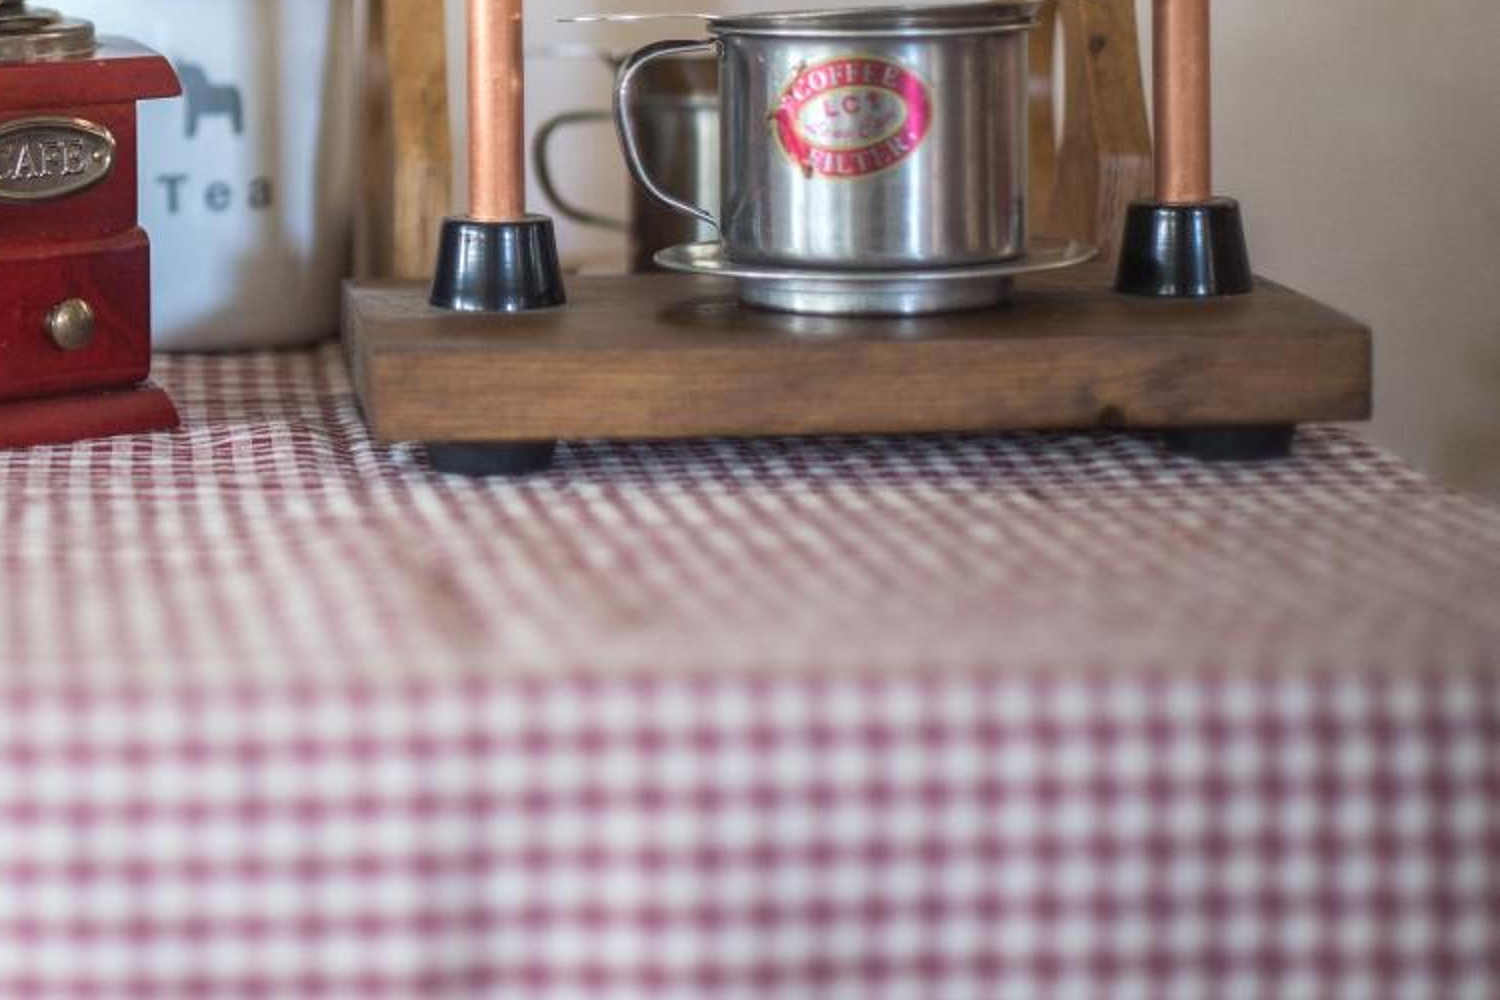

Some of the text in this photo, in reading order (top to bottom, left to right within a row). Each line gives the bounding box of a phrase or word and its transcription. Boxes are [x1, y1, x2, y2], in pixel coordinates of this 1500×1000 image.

[792, 63, 898, 101] COFFEE
[810, 136, 909, 173] FILTER
[156, 172, 274, 214] Tea
